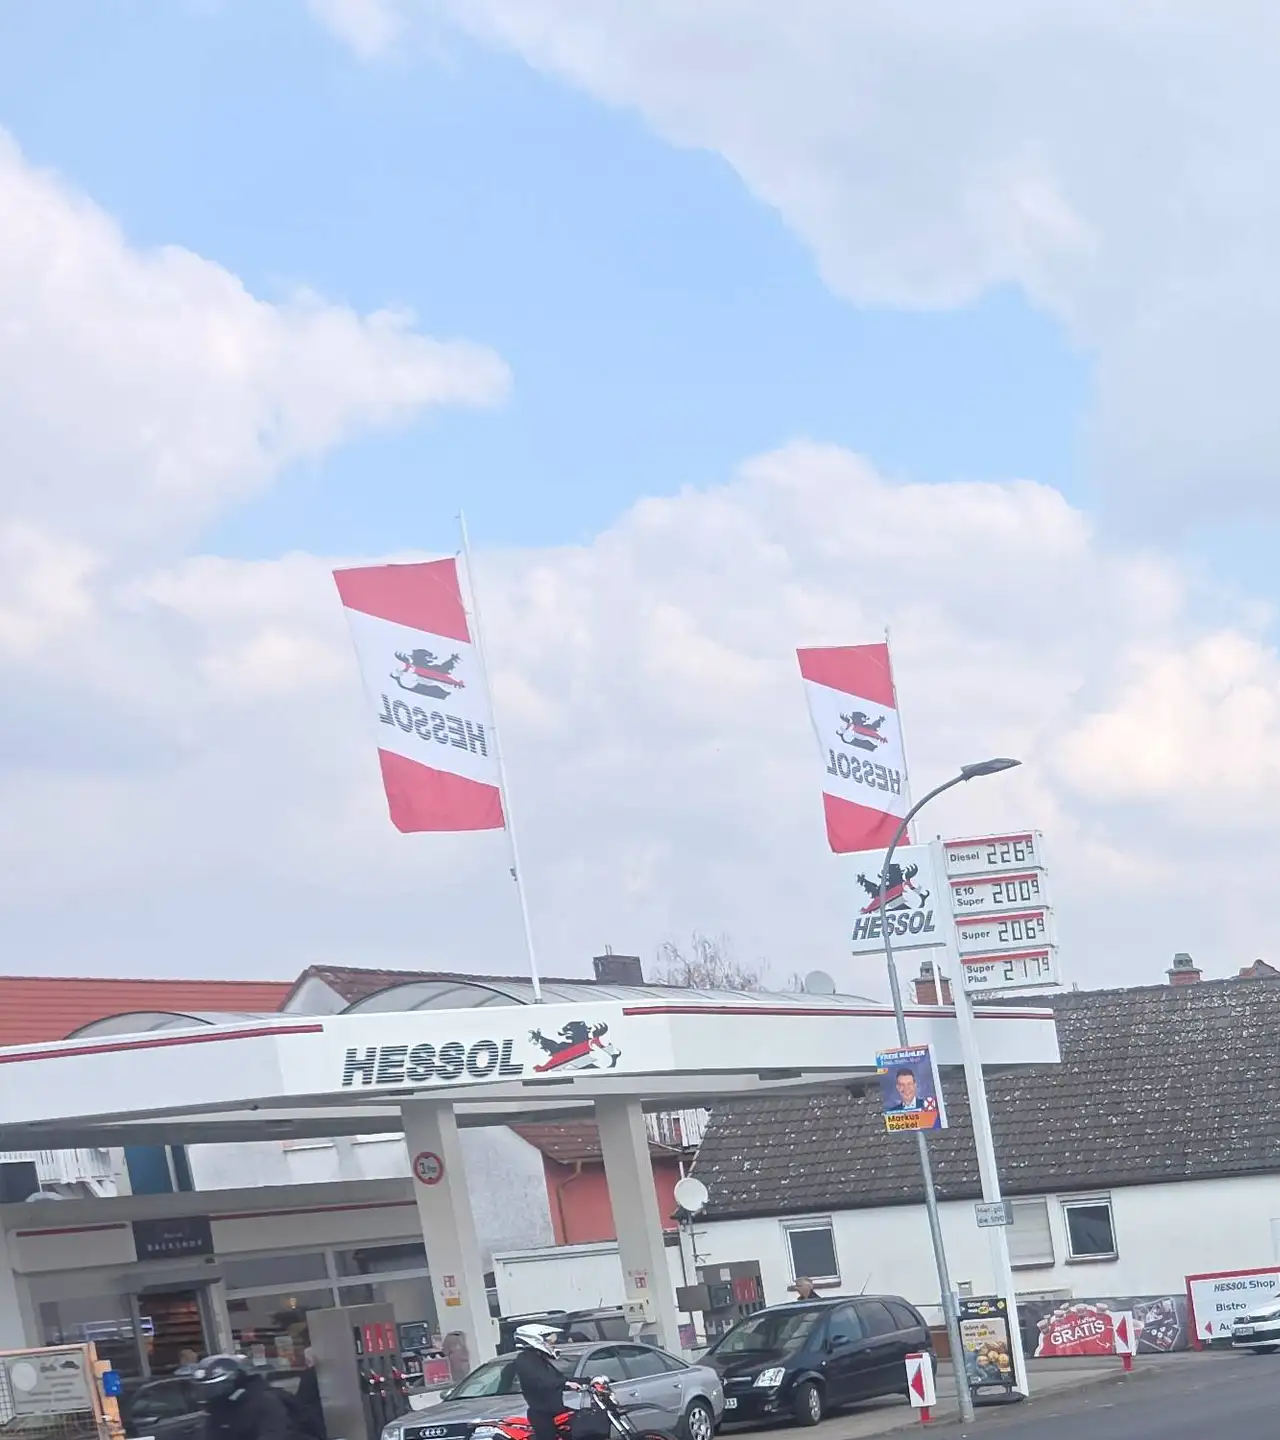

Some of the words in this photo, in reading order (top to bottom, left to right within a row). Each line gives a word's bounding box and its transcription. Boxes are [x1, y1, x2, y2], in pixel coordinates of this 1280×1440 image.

[950, 852, 980, 862] Diesel
[955, 887, 975, 896] E10
[957, 897, 985, 907] Super
[852, 910, 936, 940] HESSOL
[962, 931, 991, 940] Super
[966, 964, 996, 974] Super
[968, 975, 988, 984] Plus
[342, 1039, 524, 1087] HESSOL
[1214, 1281, 1247, 1292] HESSOL
[1248, 1280, 1275, 1289] Shop
[1216, 1302, 1247, 1312] Bistro
[1050, 1320, 1105, 1345] GRATIS
